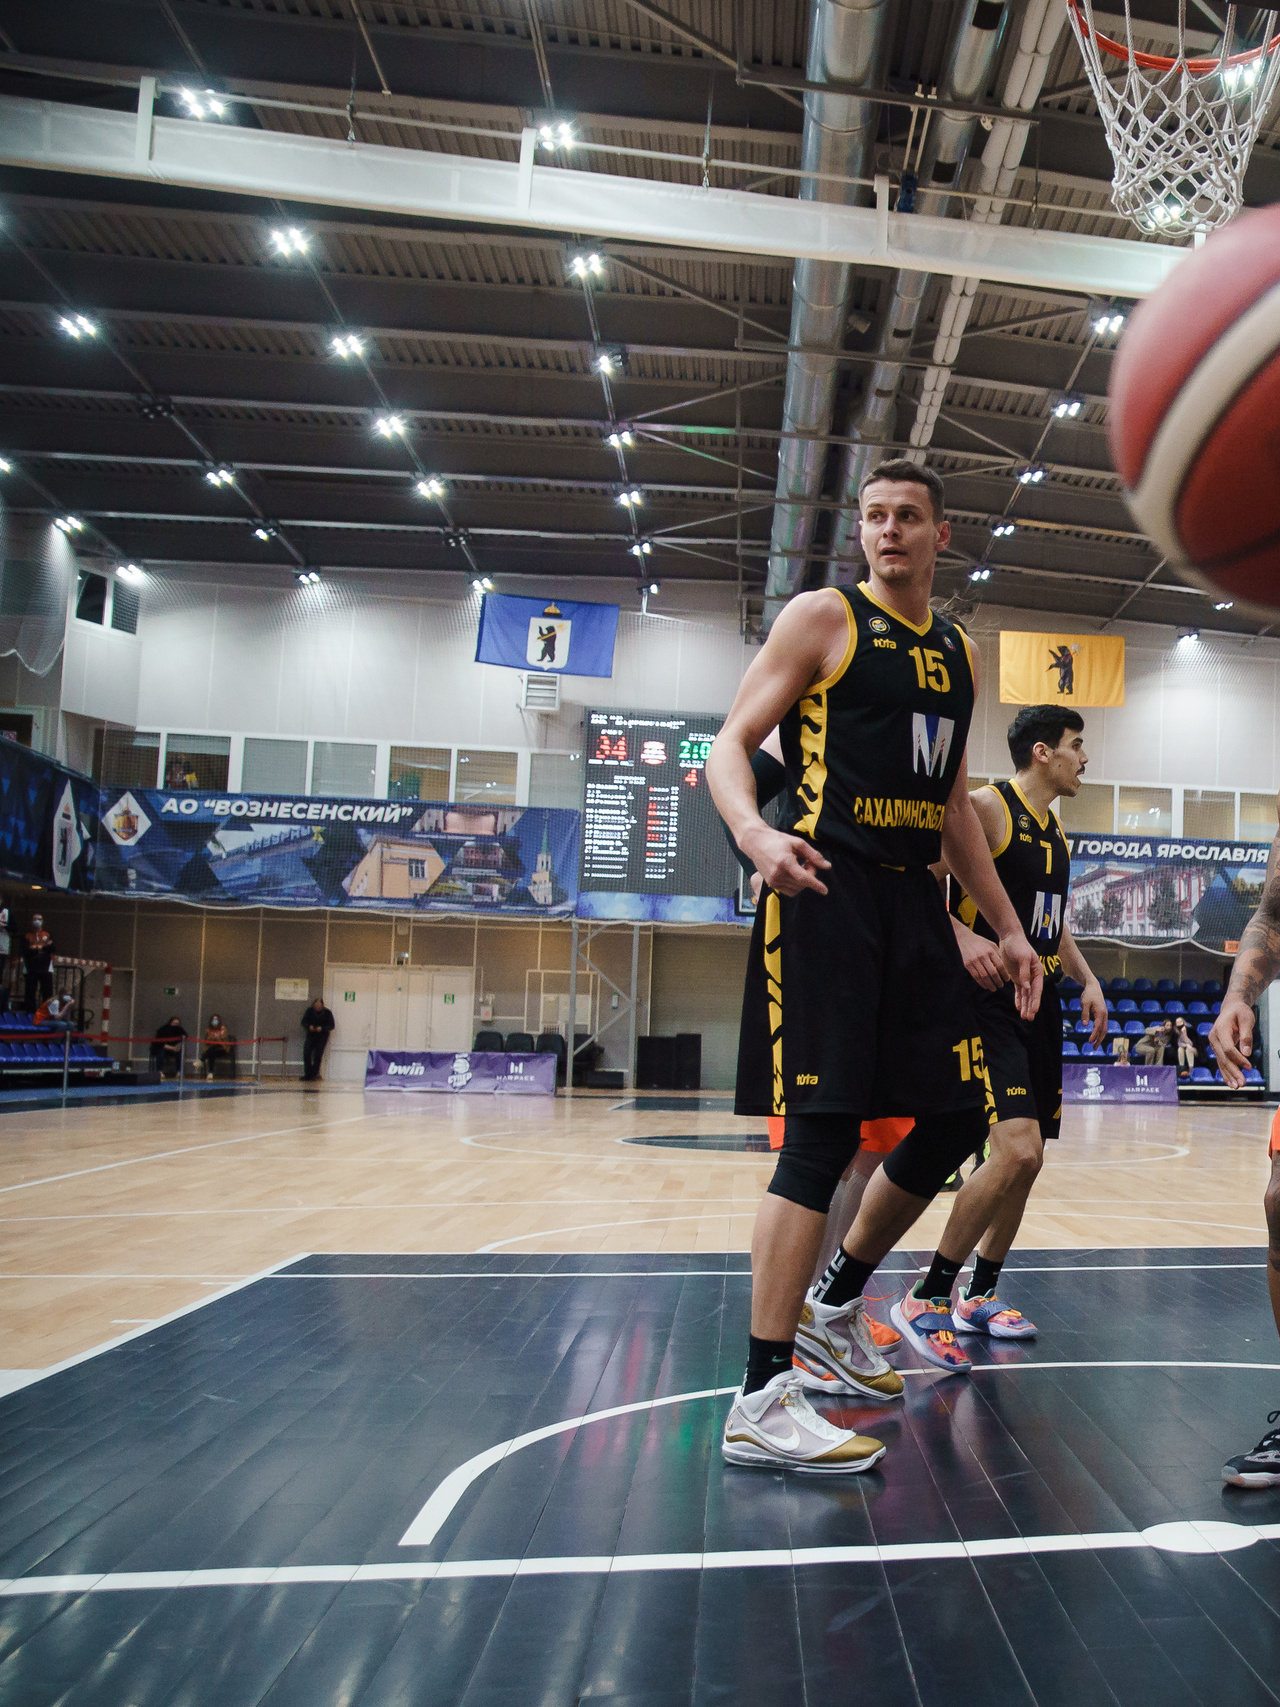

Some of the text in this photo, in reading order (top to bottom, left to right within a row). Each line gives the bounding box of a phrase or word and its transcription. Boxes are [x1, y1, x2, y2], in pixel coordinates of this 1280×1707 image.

[908, 646, 951, 693] 15
[161, 798, 198, 815] АО
[1078, 840, 1152, 859] ГОРОДА
[1157, 844, 1270, 864] ЯРОСЛАВЛЯ
[387, 1062, 426, 1076] bwin
[952, 1036, 986, 1081] 15
